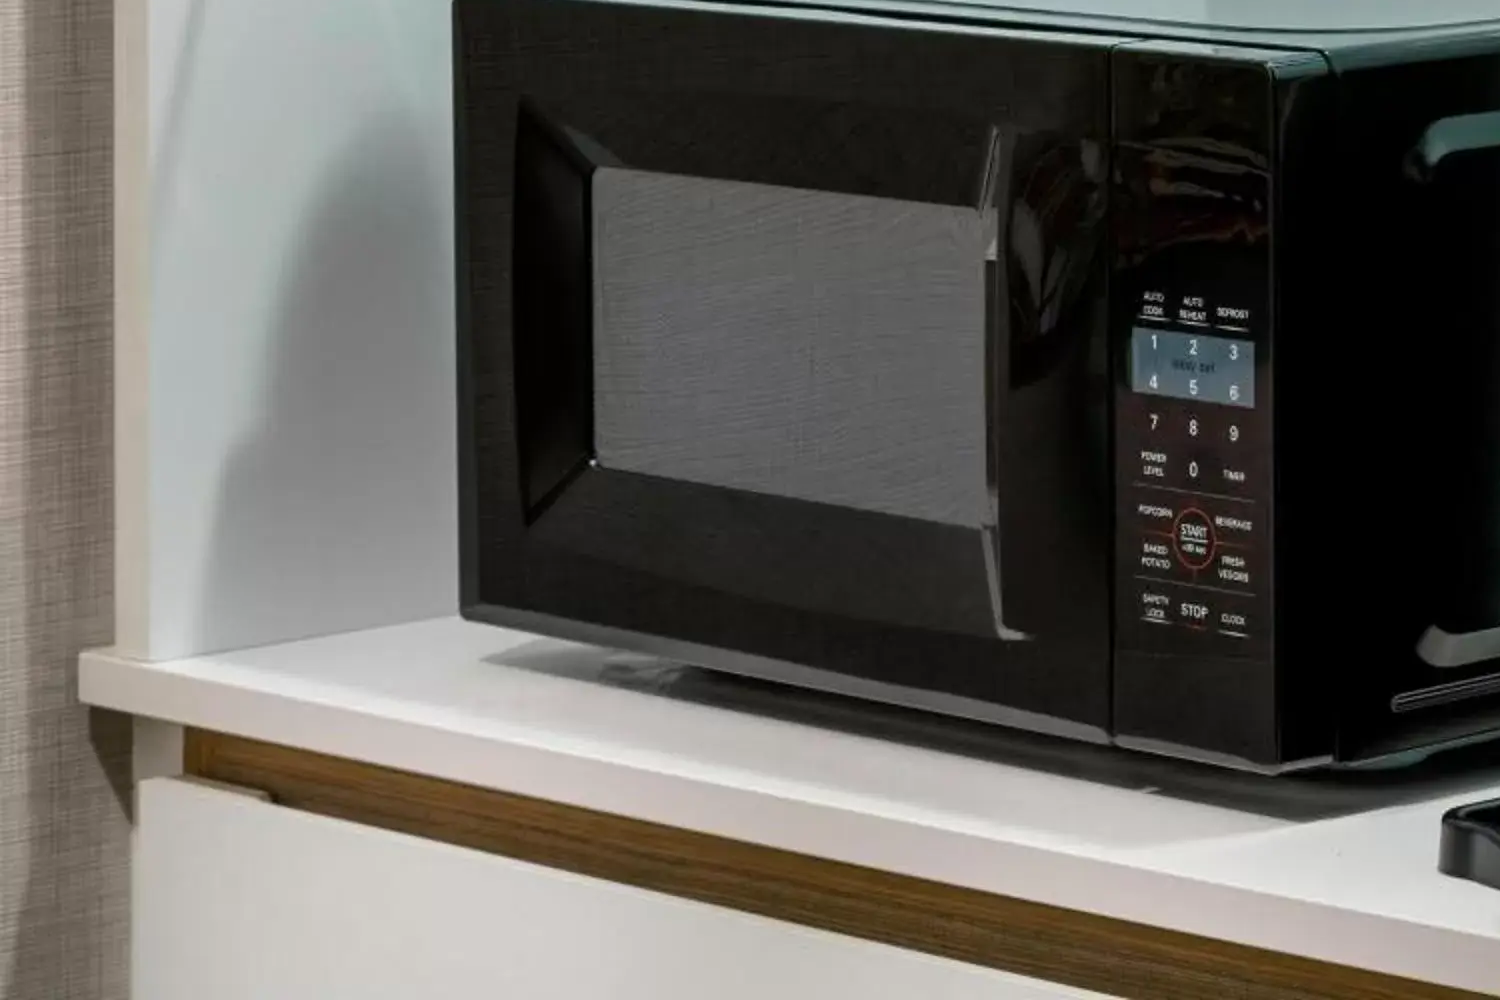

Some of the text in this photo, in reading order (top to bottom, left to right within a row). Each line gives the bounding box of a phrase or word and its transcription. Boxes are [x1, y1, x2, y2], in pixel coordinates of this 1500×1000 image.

[1151, 335, 1157, 350] 1
[1189, 339, 1198, 355] 2
[1229, 344, 1239, 360] 3
[1149, 375, 1158, 389] 4
[1189, 379, 1198, 395] 5
[1229, 386, 1239, 401] 6
[1150, 414, 1159, 430] 7
[1189, 419, 1198, 436] 8
[1229, 425, 1239, 442] 9
[1141, 451, 1167, 464] POWER
[1143, 465, 1165, 478] LEVEL
[1189, 461, 1199, 478] 0
[1223, 469, 1246, 482] TIMER
[1138, 504, 1173, 518] POPCORN
[1215, 515, 1253, 531] BEVERAGE
[1180, 523, 1208, 539] START
[1143, 543, 1168, 555] BAKED
[1141, 557, 1171, 570] POTATO
[1180, 602, 1209, 619] STOP
[1221, 613, 1245, 626] CLOCK
